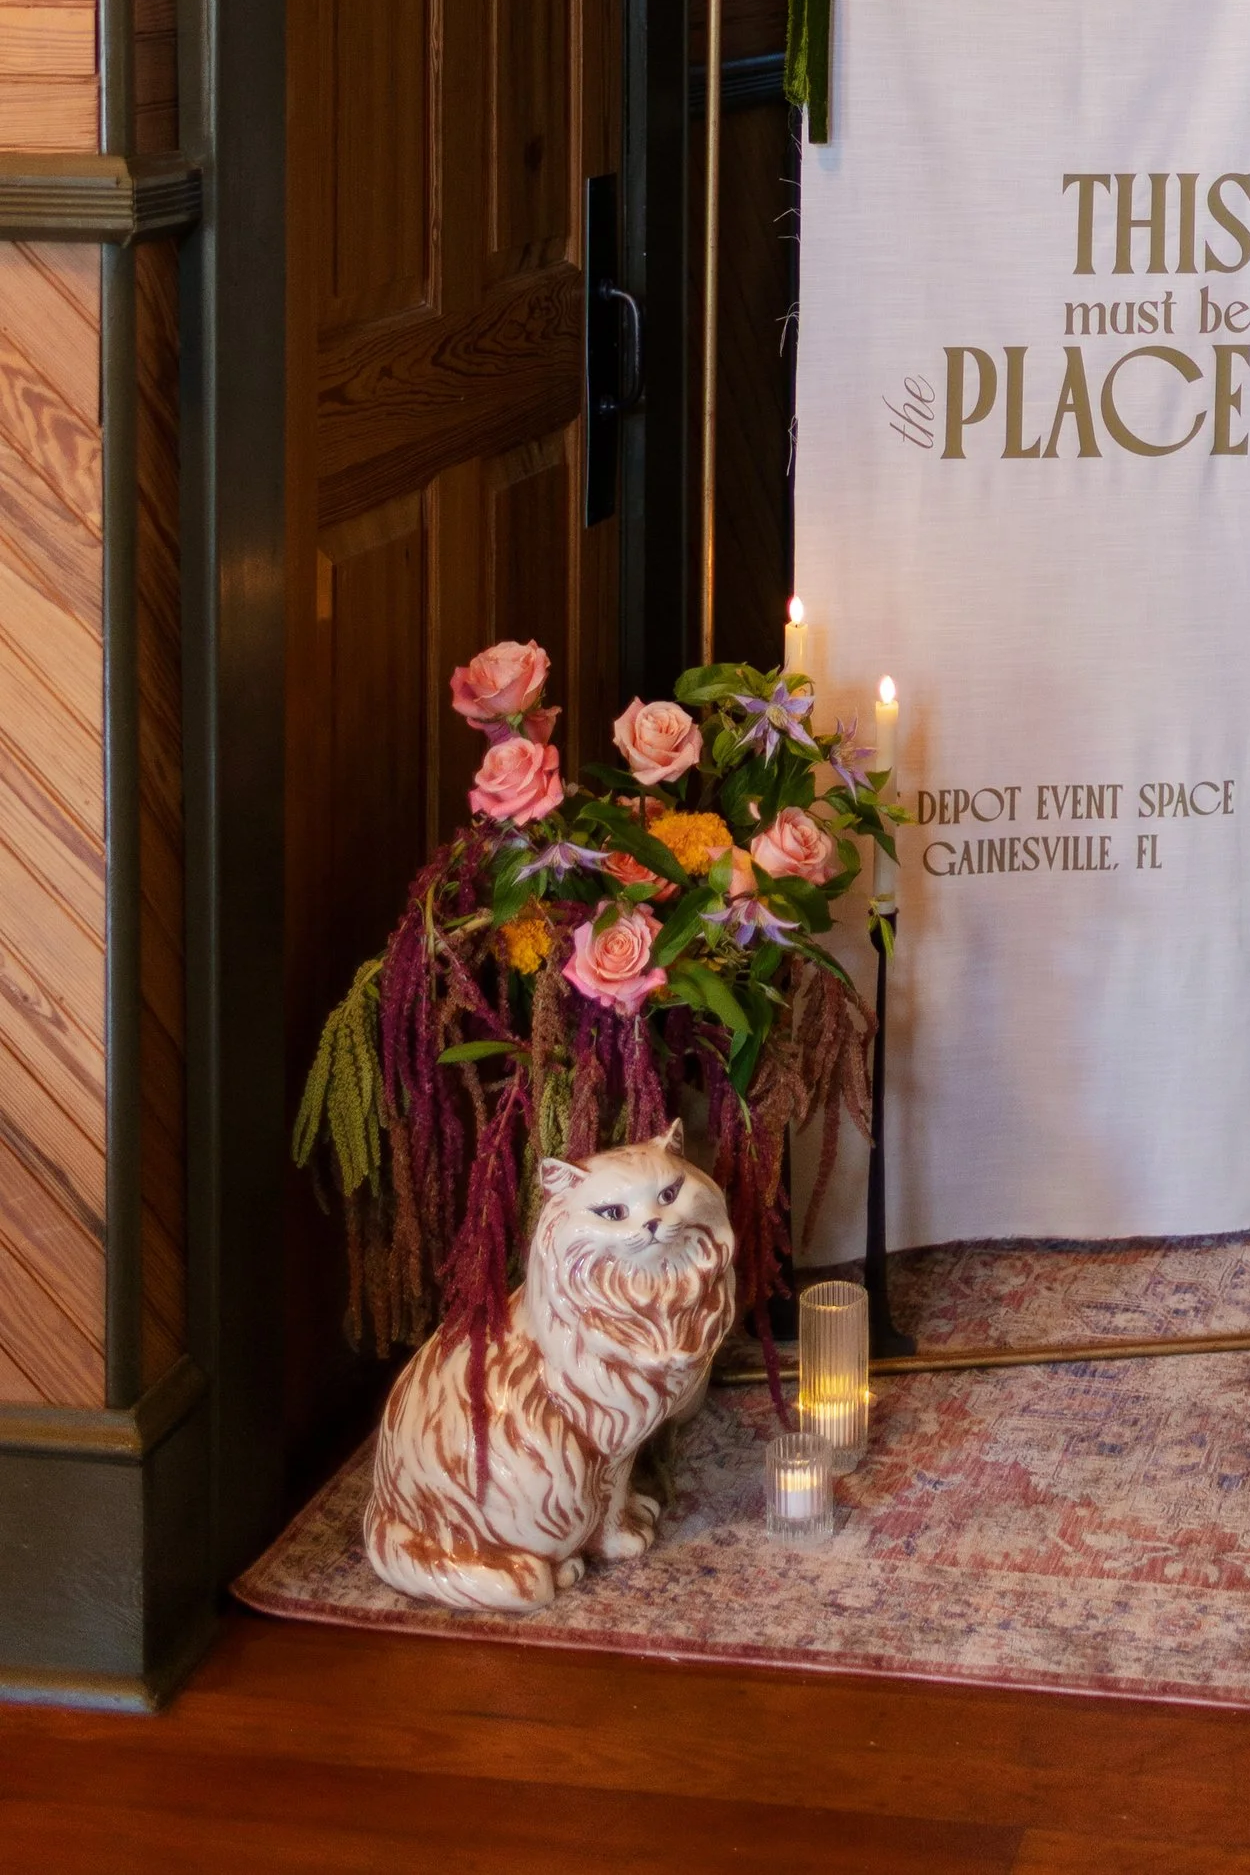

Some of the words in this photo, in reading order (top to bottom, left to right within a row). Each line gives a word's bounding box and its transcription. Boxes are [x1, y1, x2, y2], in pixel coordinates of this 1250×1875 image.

[1064, 290, 1177, 336] must
[882, 374, 936, 450] the
[917, 786, 1022, 825] DEPOT
[1036, 783, 1124, 821] EVENT
[1138, 780, 1235, 818] SPACE
[922, 835, 1120, 876] GAINESVILLE,
[1135, 833, 1163, 870] FL
